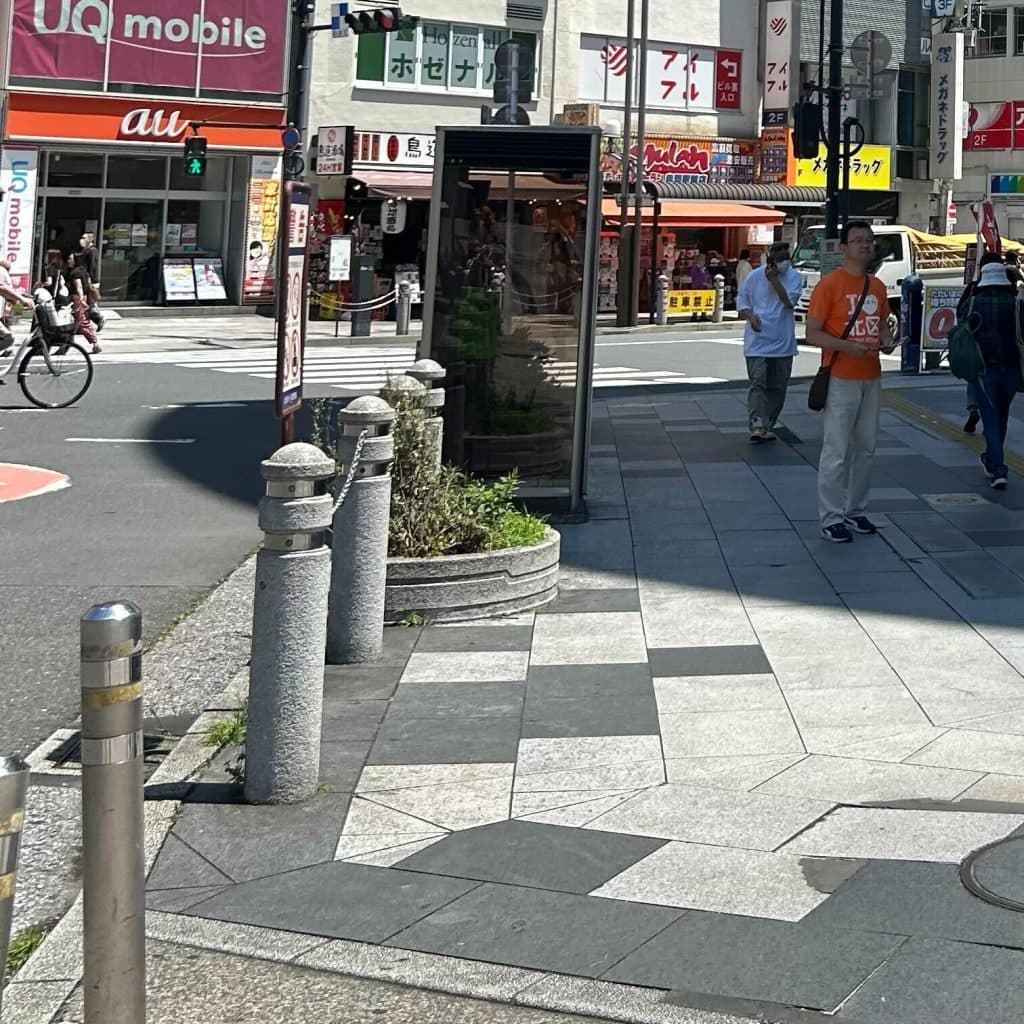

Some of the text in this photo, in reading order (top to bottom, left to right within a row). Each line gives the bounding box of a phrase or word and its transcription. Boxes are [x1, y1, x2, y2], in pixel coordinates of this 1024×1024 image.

[938, 0, 953, 11] 3F
[124, 13, 266, 50] mobile
[120, 108, 191, 138] au
[768, 112, 785, 123] 2F
[973, 134, 988, 146] 2F
[8, 160, 29, 194] UQ
[7, 197, 22, 264] mobile
[669, 295, 715, 309] 駐車禁止
